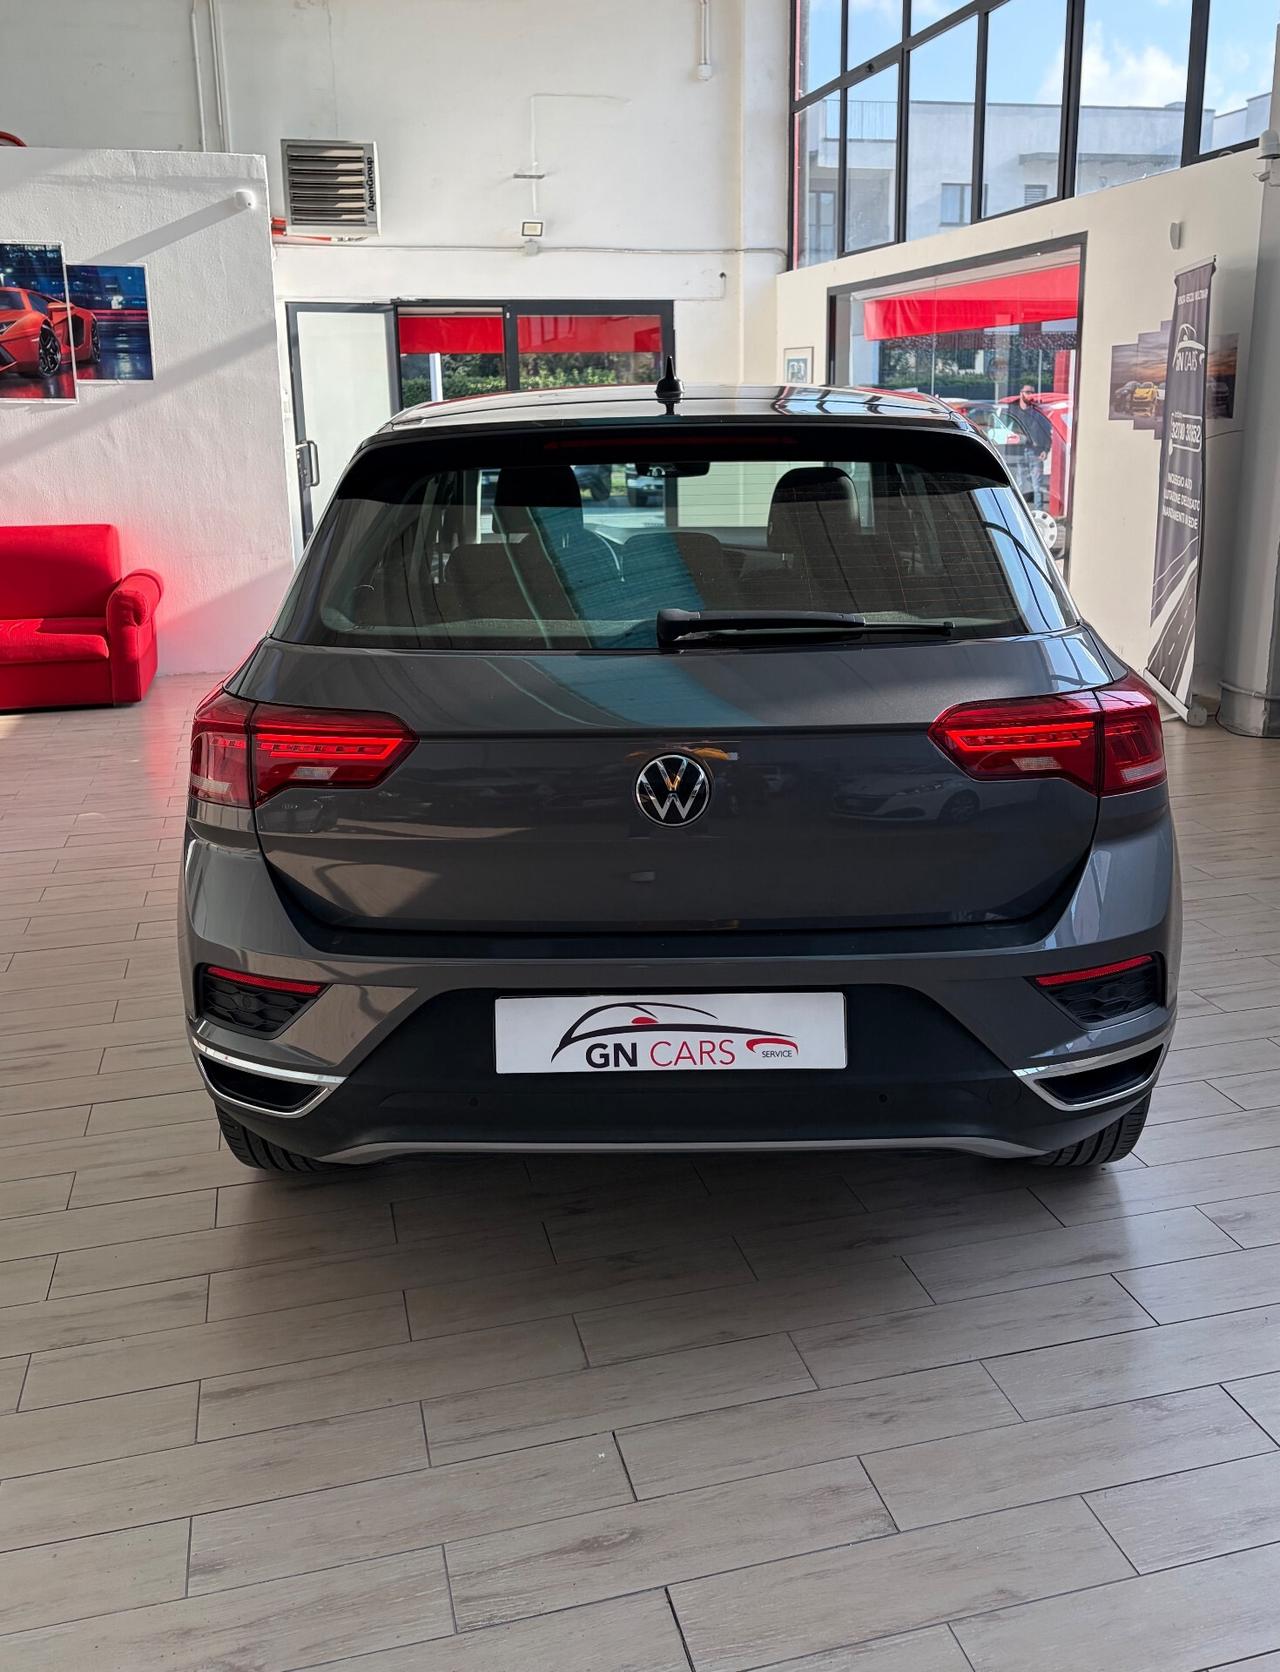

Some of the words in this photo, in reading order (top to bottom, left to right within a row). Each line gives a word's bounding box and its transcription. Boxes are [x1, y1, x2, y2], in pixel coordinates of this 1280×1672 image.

[366, 157, 376, 212] ApenGroup
[585, 1042, 638, 1069] GN
[650, 1039, 736, 1067] CARS
[761, 1050, 793, 1058] SERVICE
